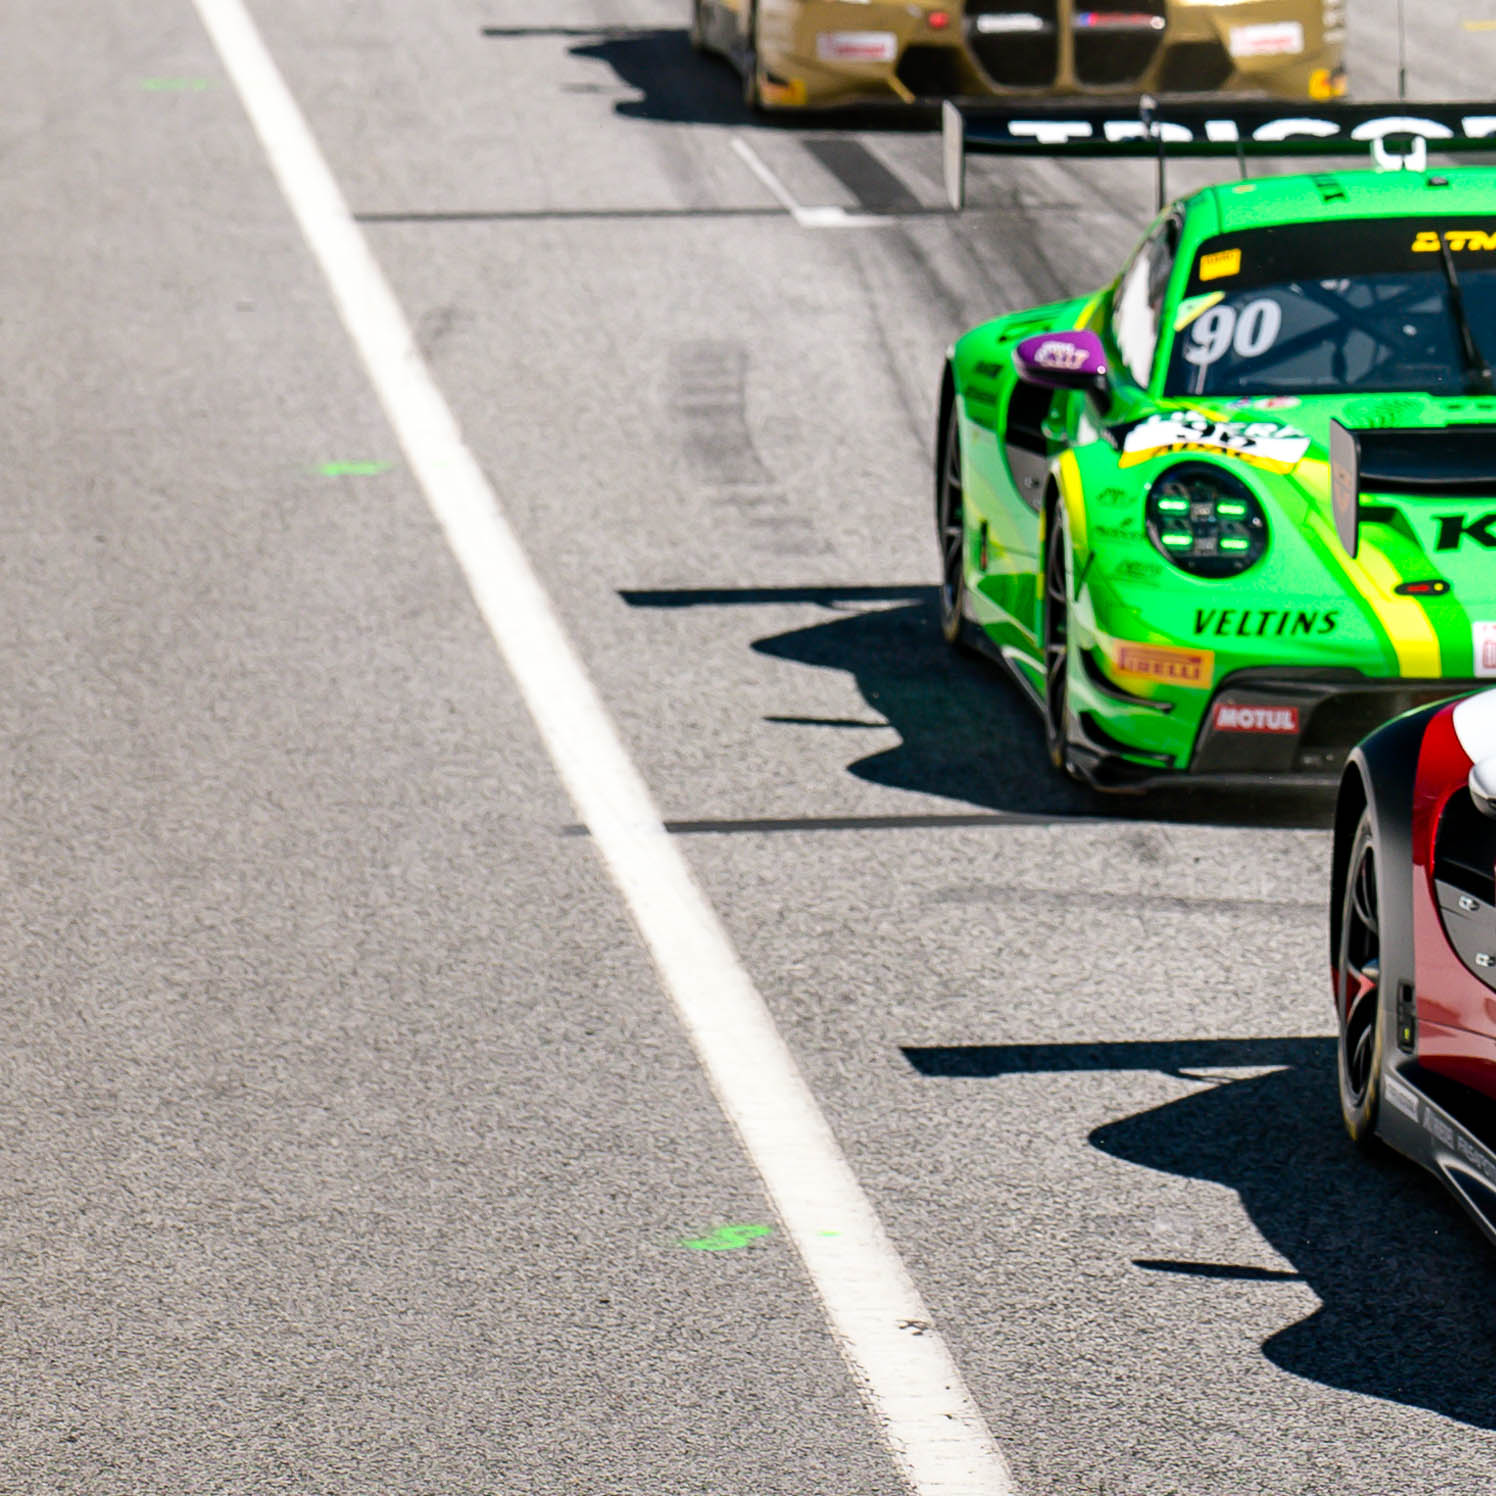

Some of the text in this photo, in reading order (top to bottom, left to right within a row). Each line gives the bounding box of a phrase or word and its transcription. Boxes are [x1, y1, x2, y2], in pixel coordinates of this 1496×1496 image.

[1184, 300, 1283, 365] 90
[1193, 609, 1339, 637] VELTINS
[1118, 646, 1203, 681] PIRELLI
[1216, 708, 1296, 730] MOTUL
